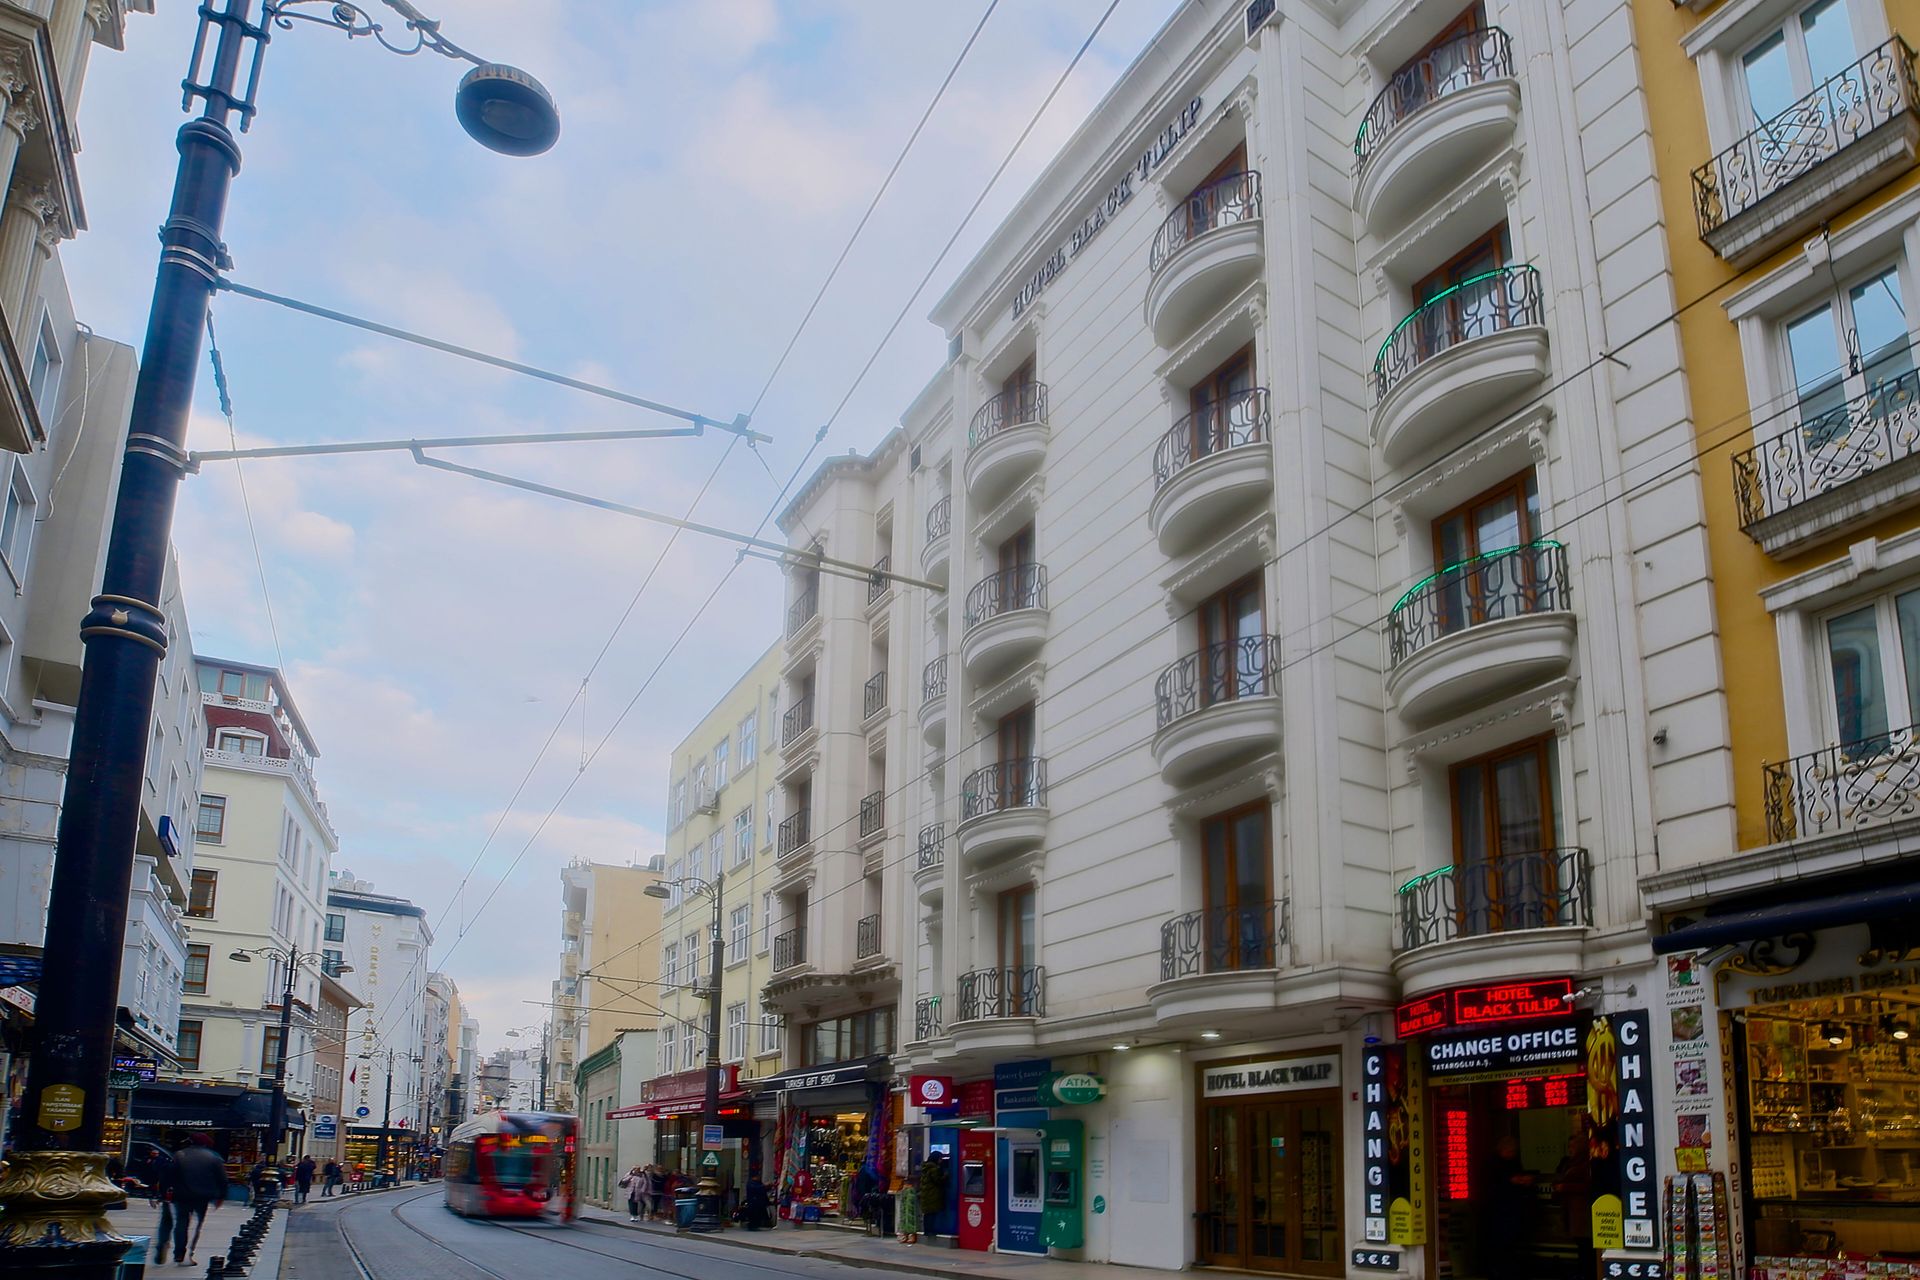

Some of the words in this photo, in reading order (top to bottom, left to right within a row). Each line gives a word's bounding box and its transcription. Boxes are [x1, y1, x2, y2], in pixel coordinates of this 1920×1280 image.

[1012, 247, 1066, 321] HOTEL
[1070, 172, 1132, 258] BLACK
[1137, 96, 1201, 181] TULIP
[1487, 988, 1534, 1002] HOTEL
[1409, 1002, 1431, 1017] HOTEL
[1463, 1003, 1512, 1018] BLACK
[1400, 1017, 1422, 1032] BLACK
[1430, 1037, 1502, 1060] CHANGE
[1507, 1028, 1577, 1051] OFFICE
[1522, 1049, 1578, 1062] COMMISSION
[806, 1076, 818, 1086] GIFT
[820, 1074, 836, 1084] SHOP
[1065, 1079, 1091, 1087] ATM
[1207, 1072, 1246, 1090] HOTEL
[1248, 1068, 1290, 1087] BLACK
[1720, 1027, 1735, 1142] TURKISH
[176, 1119, 213, 1127] KITCHEN'S
[1620, 1020, 1646, 1216] CHANGE
[1367, 1056, 1382, 1214] CHANGE
